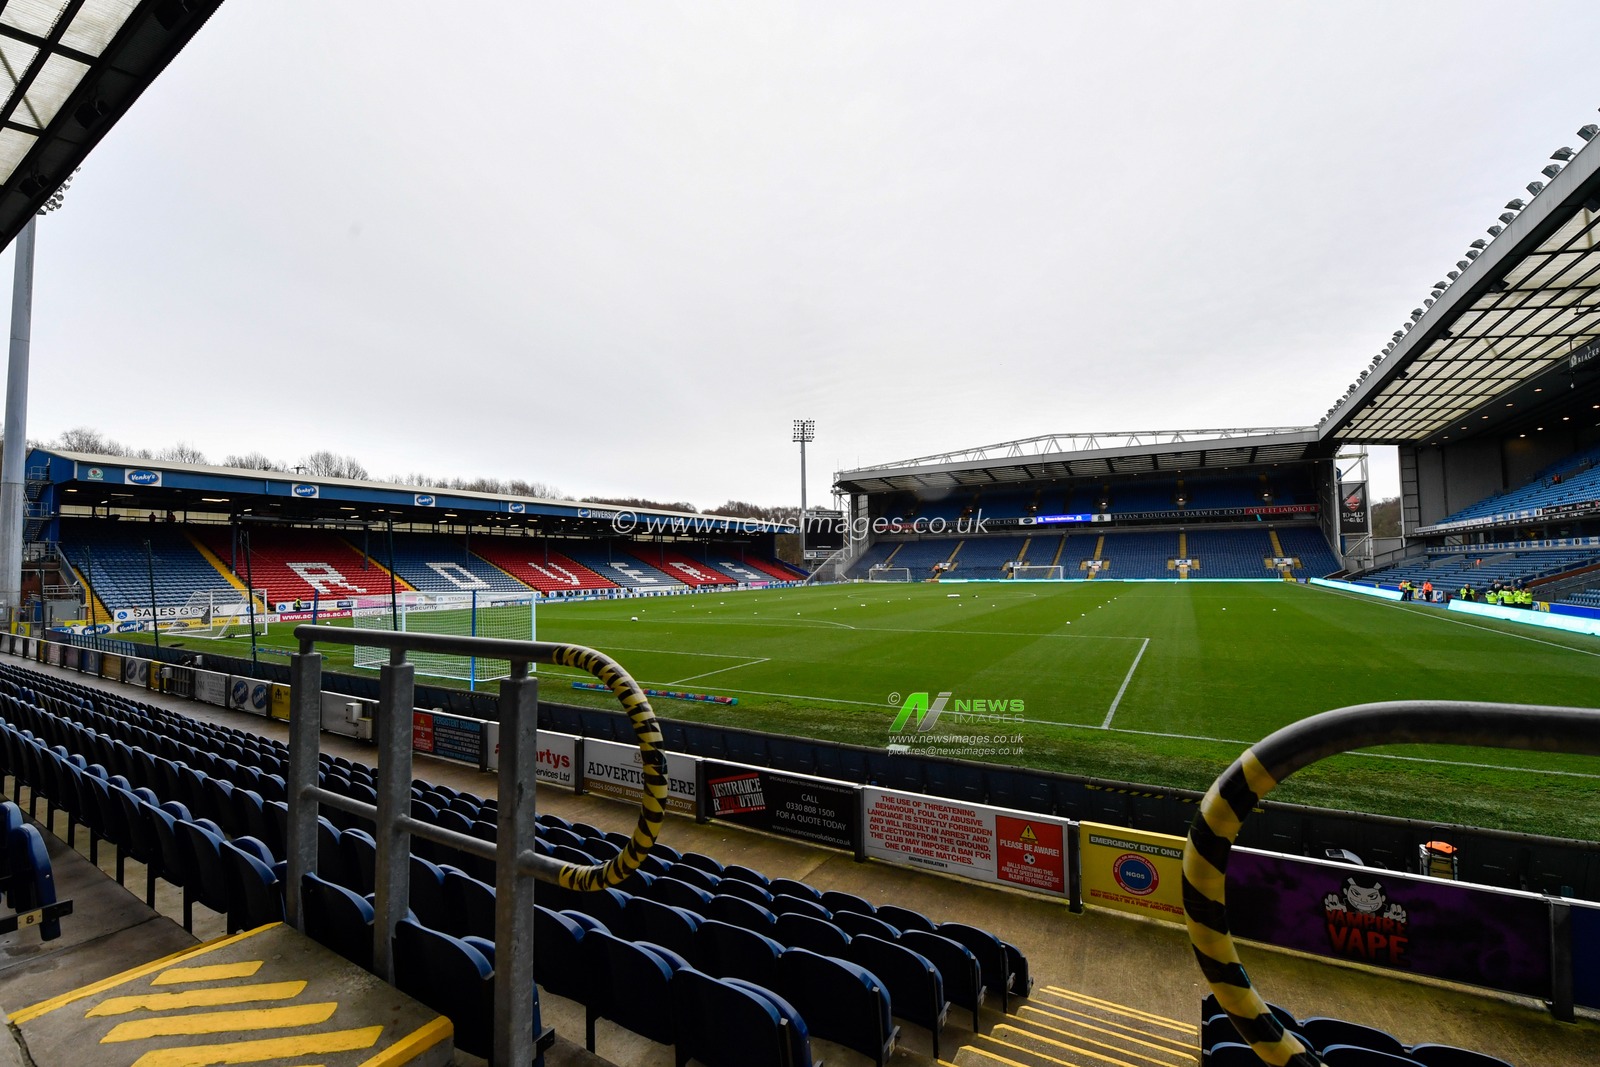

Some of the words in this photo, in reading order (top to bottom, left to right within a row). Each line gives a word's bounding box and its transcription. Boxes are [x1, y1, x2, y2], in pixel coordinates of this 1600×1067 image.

[131, 473, 156, 481] Venky's
[1184, 510, 1220, 518] DARWEN
[1224, 508, 1242, 516] END
[558, 771, 570, 782] Ltd
[801, 793, 819, 804] CALL
[881, 796, 896, 804] THE
[896, 798, 911, 806] USE
[912, 800, 922, 808] OF
[924, 802, 976, 818] THREATENING
[776, 810, 790, 820] FOR
[790, 812, 796, 822] A
[797, 814, 822, 826] QUOTE
[822, 818, 847, 831] TODAY
[786, 802, 802, 812] 0330
[803, 804, 817, 815] 808
[818, 806, 836, 818] 1500
[876, 802, 916, 816] BEHAVIOUR,
[918, 810, 936, 818] FOUL
[938, 812, 949, 820] OR
[950, 814, 983, 826] ABUSIVE
[868, 808, 904, 820] LANGUAGE
[904, 814, 912, 822] IS
[914, 816, 948, 828] STRICTLY
[948, 820, 993, 836] FORBIDDEN
[870, 816, 884, 824] AND
[886, 819, 901, 828] WILL
[902, 822, 930, 832] RESULT
[931, 826, 939, 834] IN
[940, 828, 970, 840] ARREST
[772, 824, 852, 846] www.insurancerevolution.co.uk
[870, 824, 880, 832] OR
[881, 825, 916, 838] EJECTION
[917, 832, 938, 842] FROM
[939, 836, 954, 845] THE
[956, 838, 992, 852] GROUND.
[870, 831, 884, 840] THE
[885, 834, 904, 844] CLUB
[905, 837, 920, 846] MAY
[922, 840, 950, 852] IMPOSE
[958, 846, 974, 856] BAN
[975, 850, 992, 860] FOR
[884, 841, 900, 850] ONE
[901, 844, 912, 852] OR
[912, 847, 934, 857] MORE
[936, 851, 974, 866] MATCHES.
[1000, 838, 1024, 850] PLEASE
[1024, 843, 1033, 852] BE
[1034, 844, 1060, 857] AWARE!
[1090, 836, 1139, 850] EMERGENCY
[1140, 844, 1159, 854] EXIT
[1160, 848, 1182, 858] ONLY
[1002, 866, 1014, 874] AREA
[1019, 870, 1034, 878] SPEED
[1044, 874, 1060, 884] CAUSE
[1006, 862, 1020, 870] BALLS
[1020, 864, 1042, 874] ENTERING
[1008, 872, 1025, 881] INJURY
[1102, 893, 1122, 902] RESULT
[1136, 900, 1149, 908] FINE
[26, 915, 34, 924] 8
[1326, 909, 1407, 934] VAMPIRE
[1328, 923, 1411, 967] VAPE
